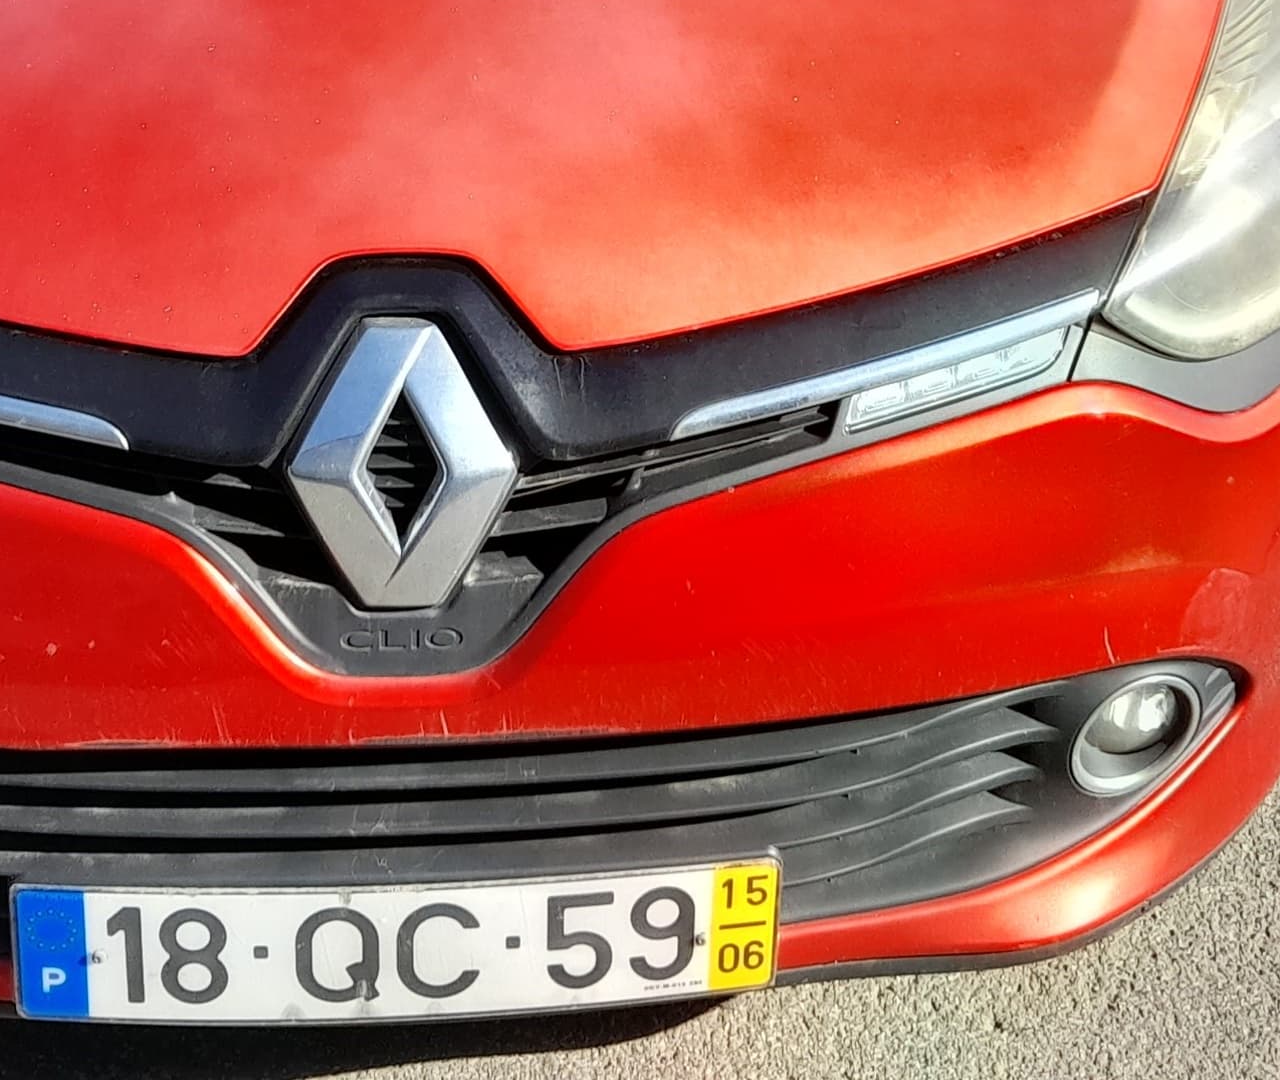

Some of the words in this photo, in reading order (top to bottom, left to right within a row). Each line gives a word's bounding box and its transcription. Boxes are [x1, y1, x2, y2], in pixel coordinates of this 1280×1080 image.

[340, 627, 464, 653] CLIO
[721, 874, 769, 910] 15
[718, 940, 765, 974] 06
[41, 967, 67, 993] P
